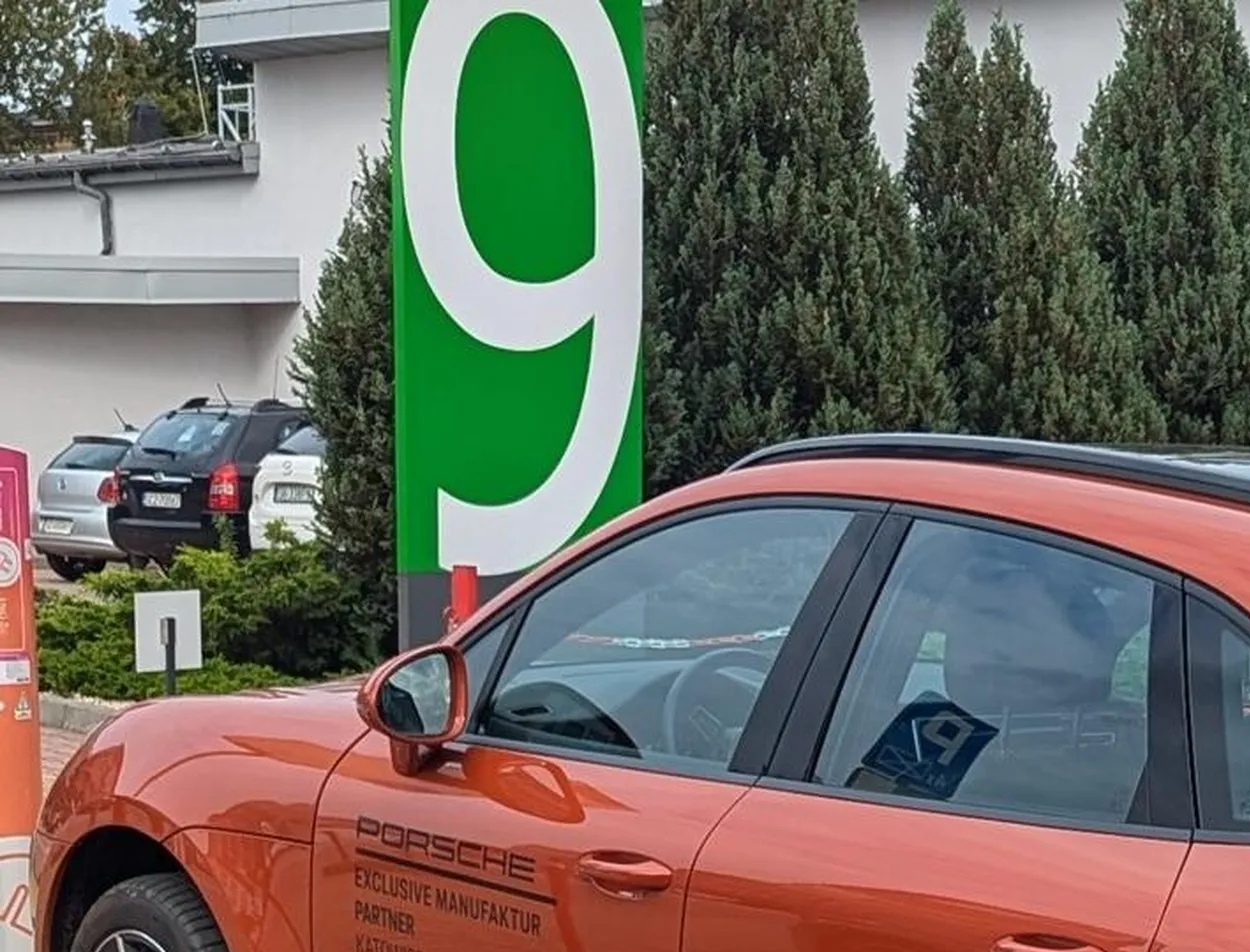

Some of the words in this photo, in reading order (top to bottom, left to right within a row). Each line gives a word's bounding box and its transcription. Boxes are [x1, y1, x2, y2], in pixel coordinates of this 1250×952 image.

[401, 0, 643, 577] 9
[356, 815, 537, 883] PORSCHE
[354, 866, 433, 907] EXCLUSIVE
[435, 887, 542, 936] MANUFAKTUR
[354, 899, 415, 936] PARTNER
